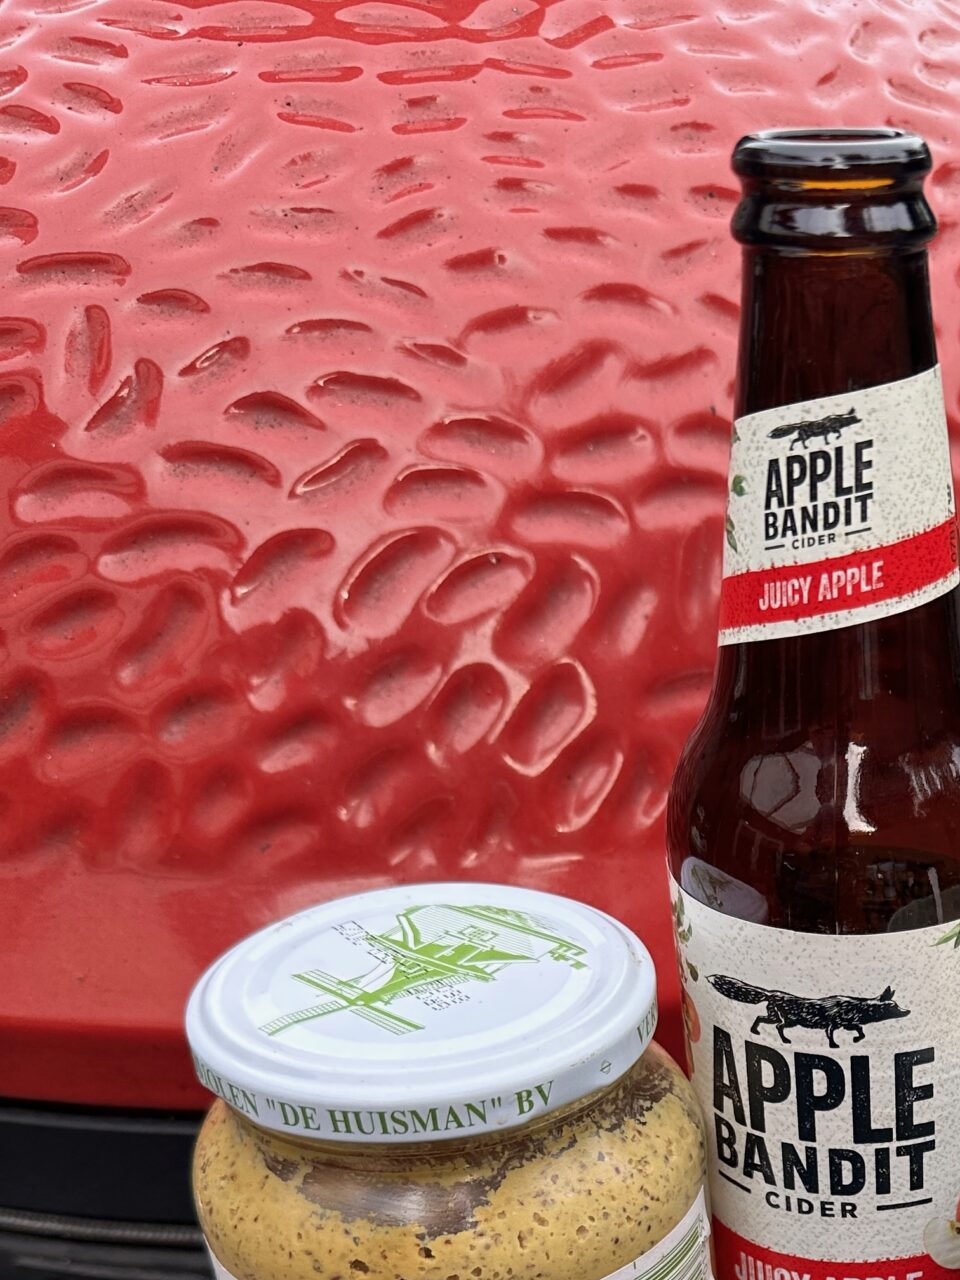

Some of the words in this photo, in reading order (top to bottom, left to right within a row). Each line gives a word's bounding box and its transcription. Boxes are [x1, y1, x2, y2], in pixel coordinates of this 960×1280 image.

[764, 439, 873, 511] APPLE
[764, 492, 873, 541] BANDIT
[791, 533, 837, 550] CIDER
[759, 575, 812, 611] JUICY
[818, 561, 884, 602] APPLE
[266, 1098, 321, 1132] "DE
[331, 1096, 501, 1136] HUISMAN"
[514, 1080, 554, 1116] BV
[712, 1025, 936, 1143] APPLE
[714, 1113, 936, 1196] BANDIT
[766, 1191, 858, 1218] CIDER
